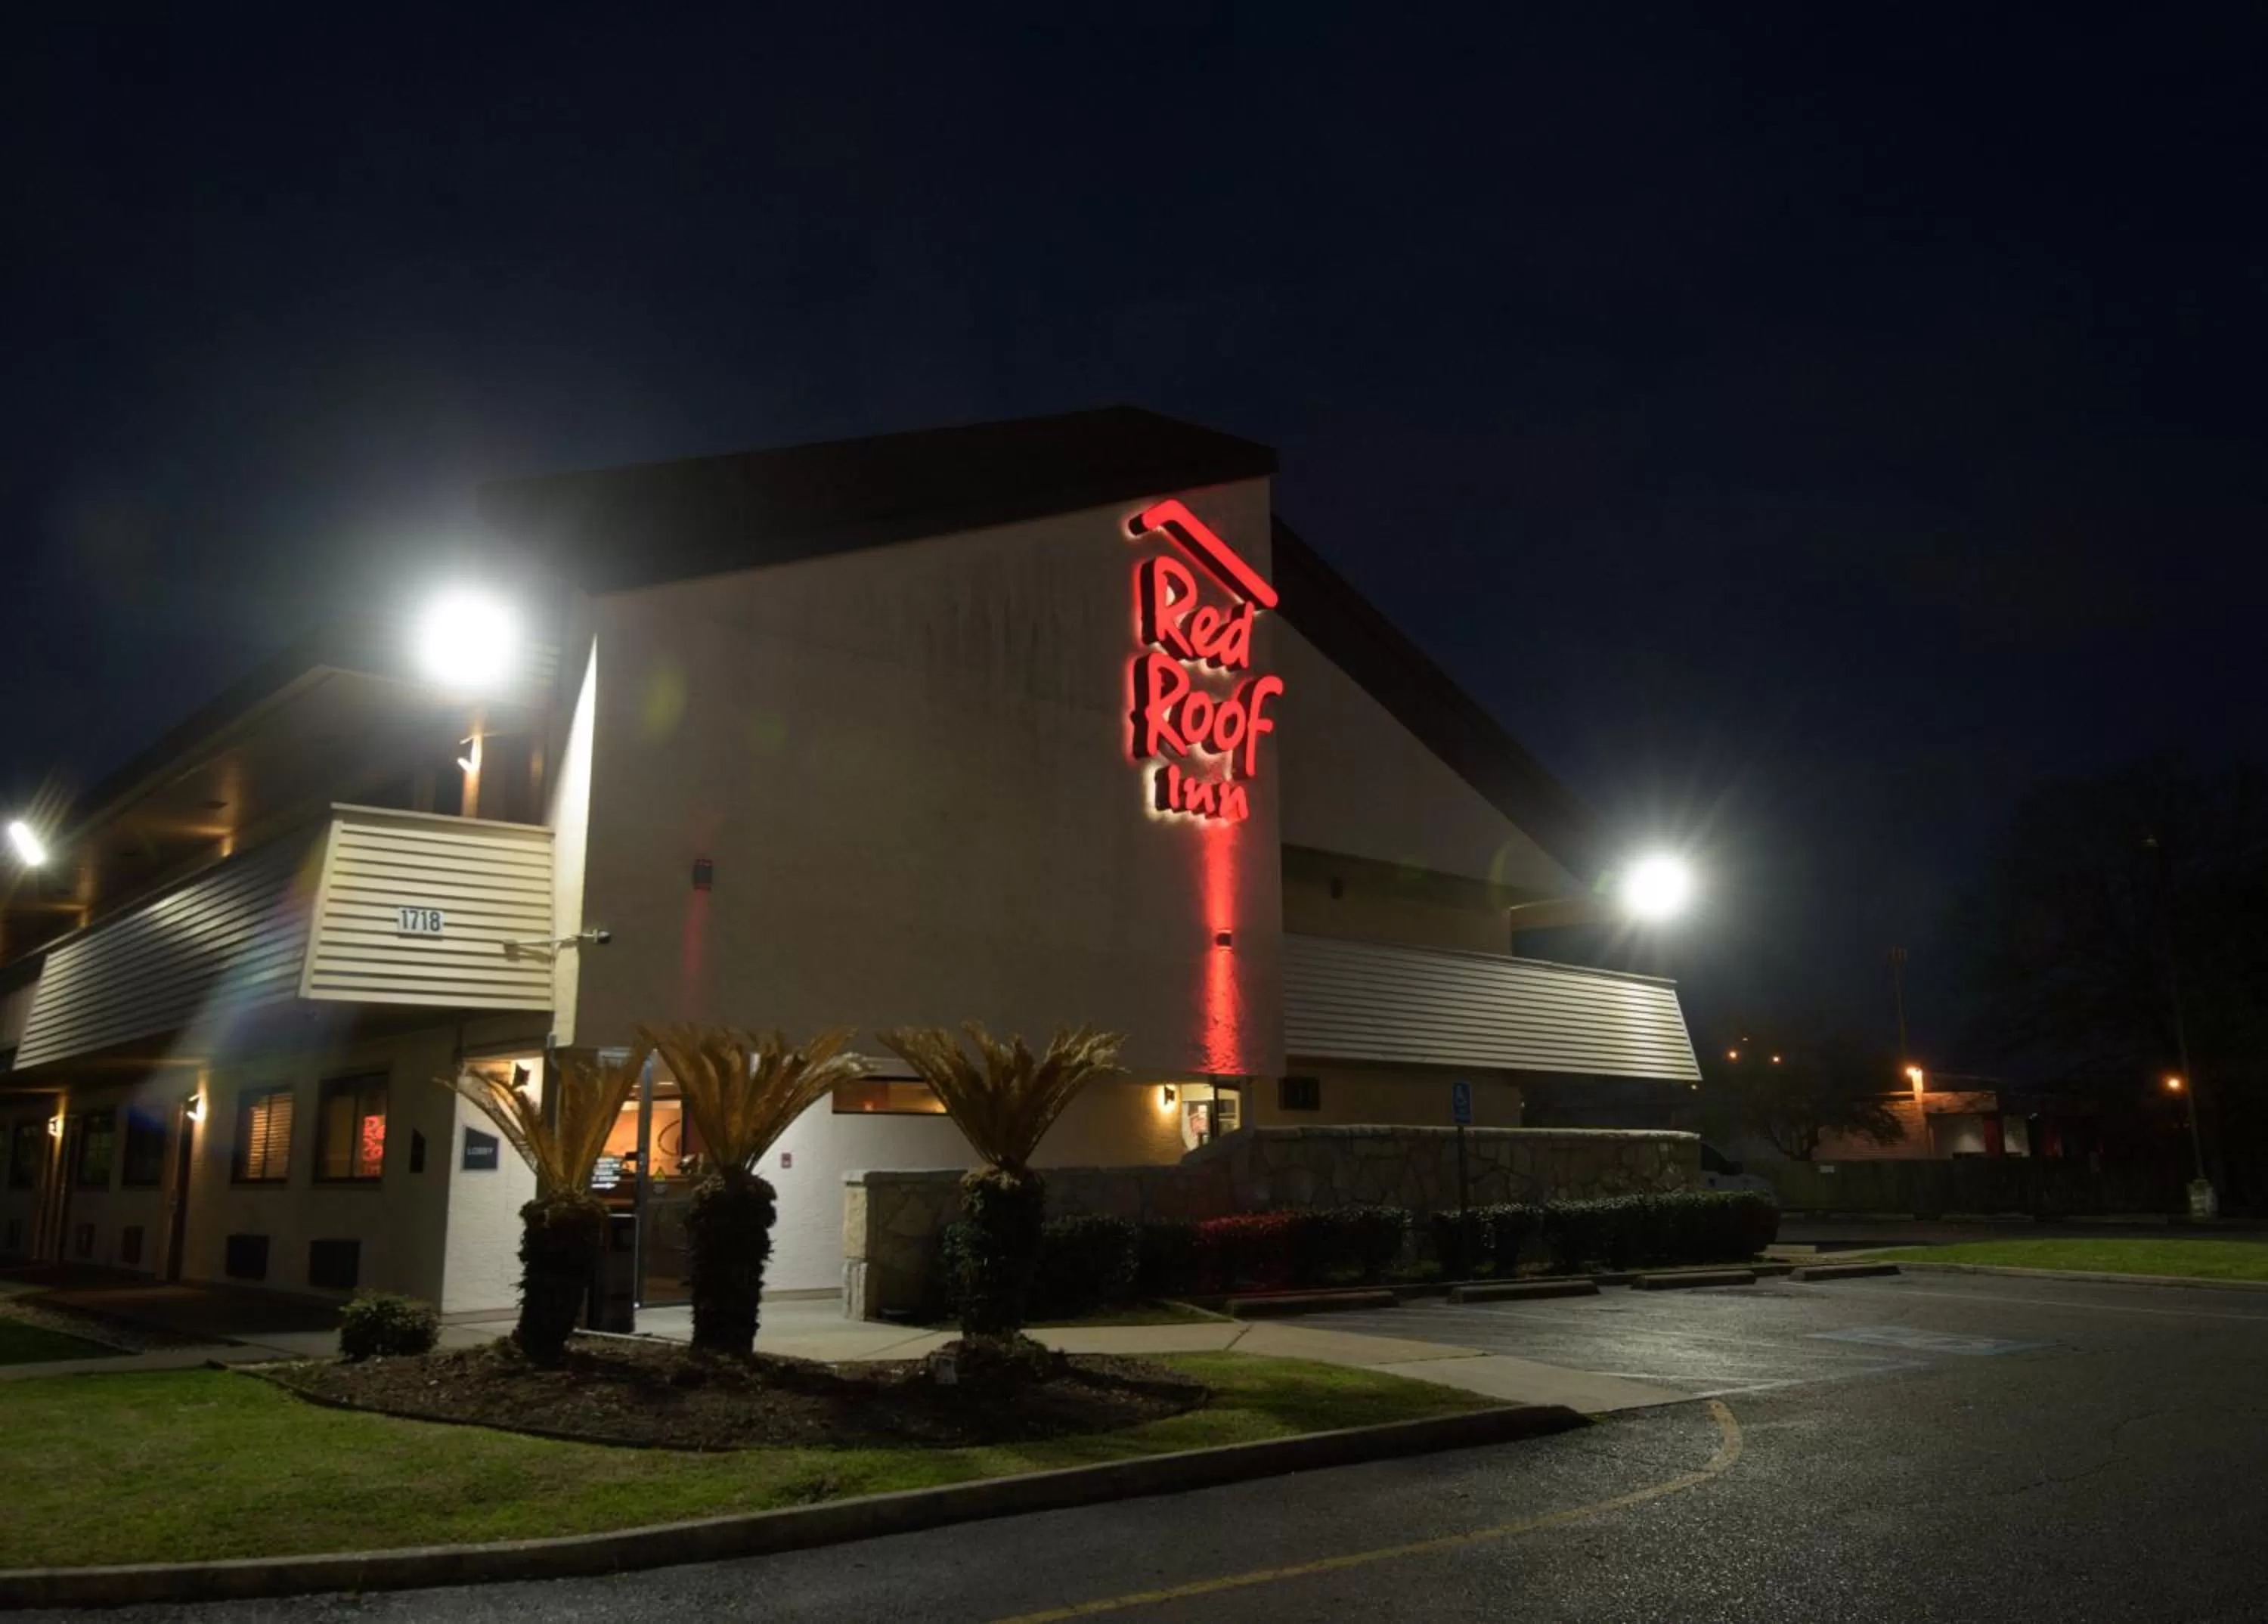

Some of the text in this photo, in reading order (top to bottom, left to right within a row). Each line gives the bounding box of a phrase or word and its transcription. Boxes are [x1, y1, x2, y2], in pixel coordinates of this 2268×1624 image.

[1153, 555, 1254, 668] Red
[1144, 652, 1284, 776] Roof
[1167, 763, 1249, 820] Inn
[401, 910, 441, 931] 1718
